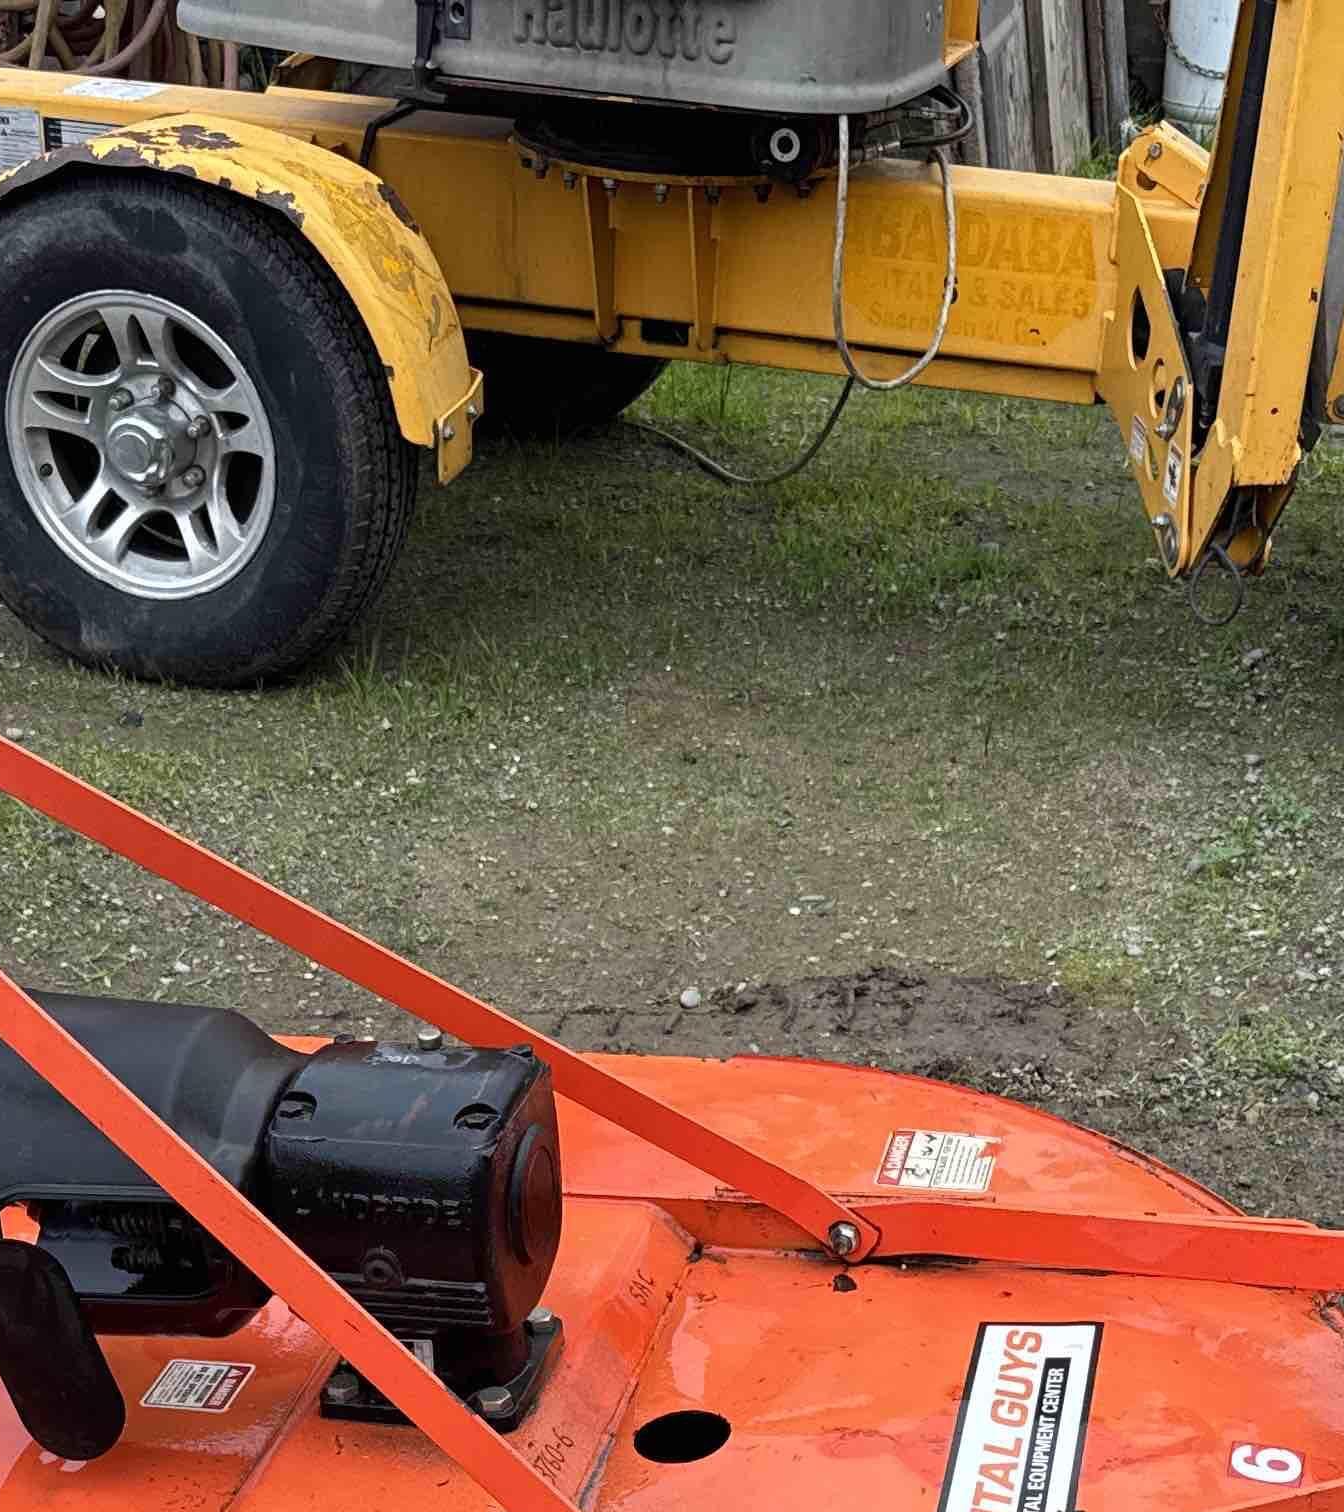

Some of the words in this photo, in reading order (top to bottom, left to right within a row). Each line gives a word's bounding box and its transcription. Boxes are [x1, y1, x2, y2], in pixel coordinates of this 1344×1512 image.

[990, 1329, 1042, 1427] GUYS
[1027, 1415, 1055, 1488] EQUIPMENT
[1042, 1367, 1064, 1413] CENTER
[1232, 1445, 1301, 1482] 6
